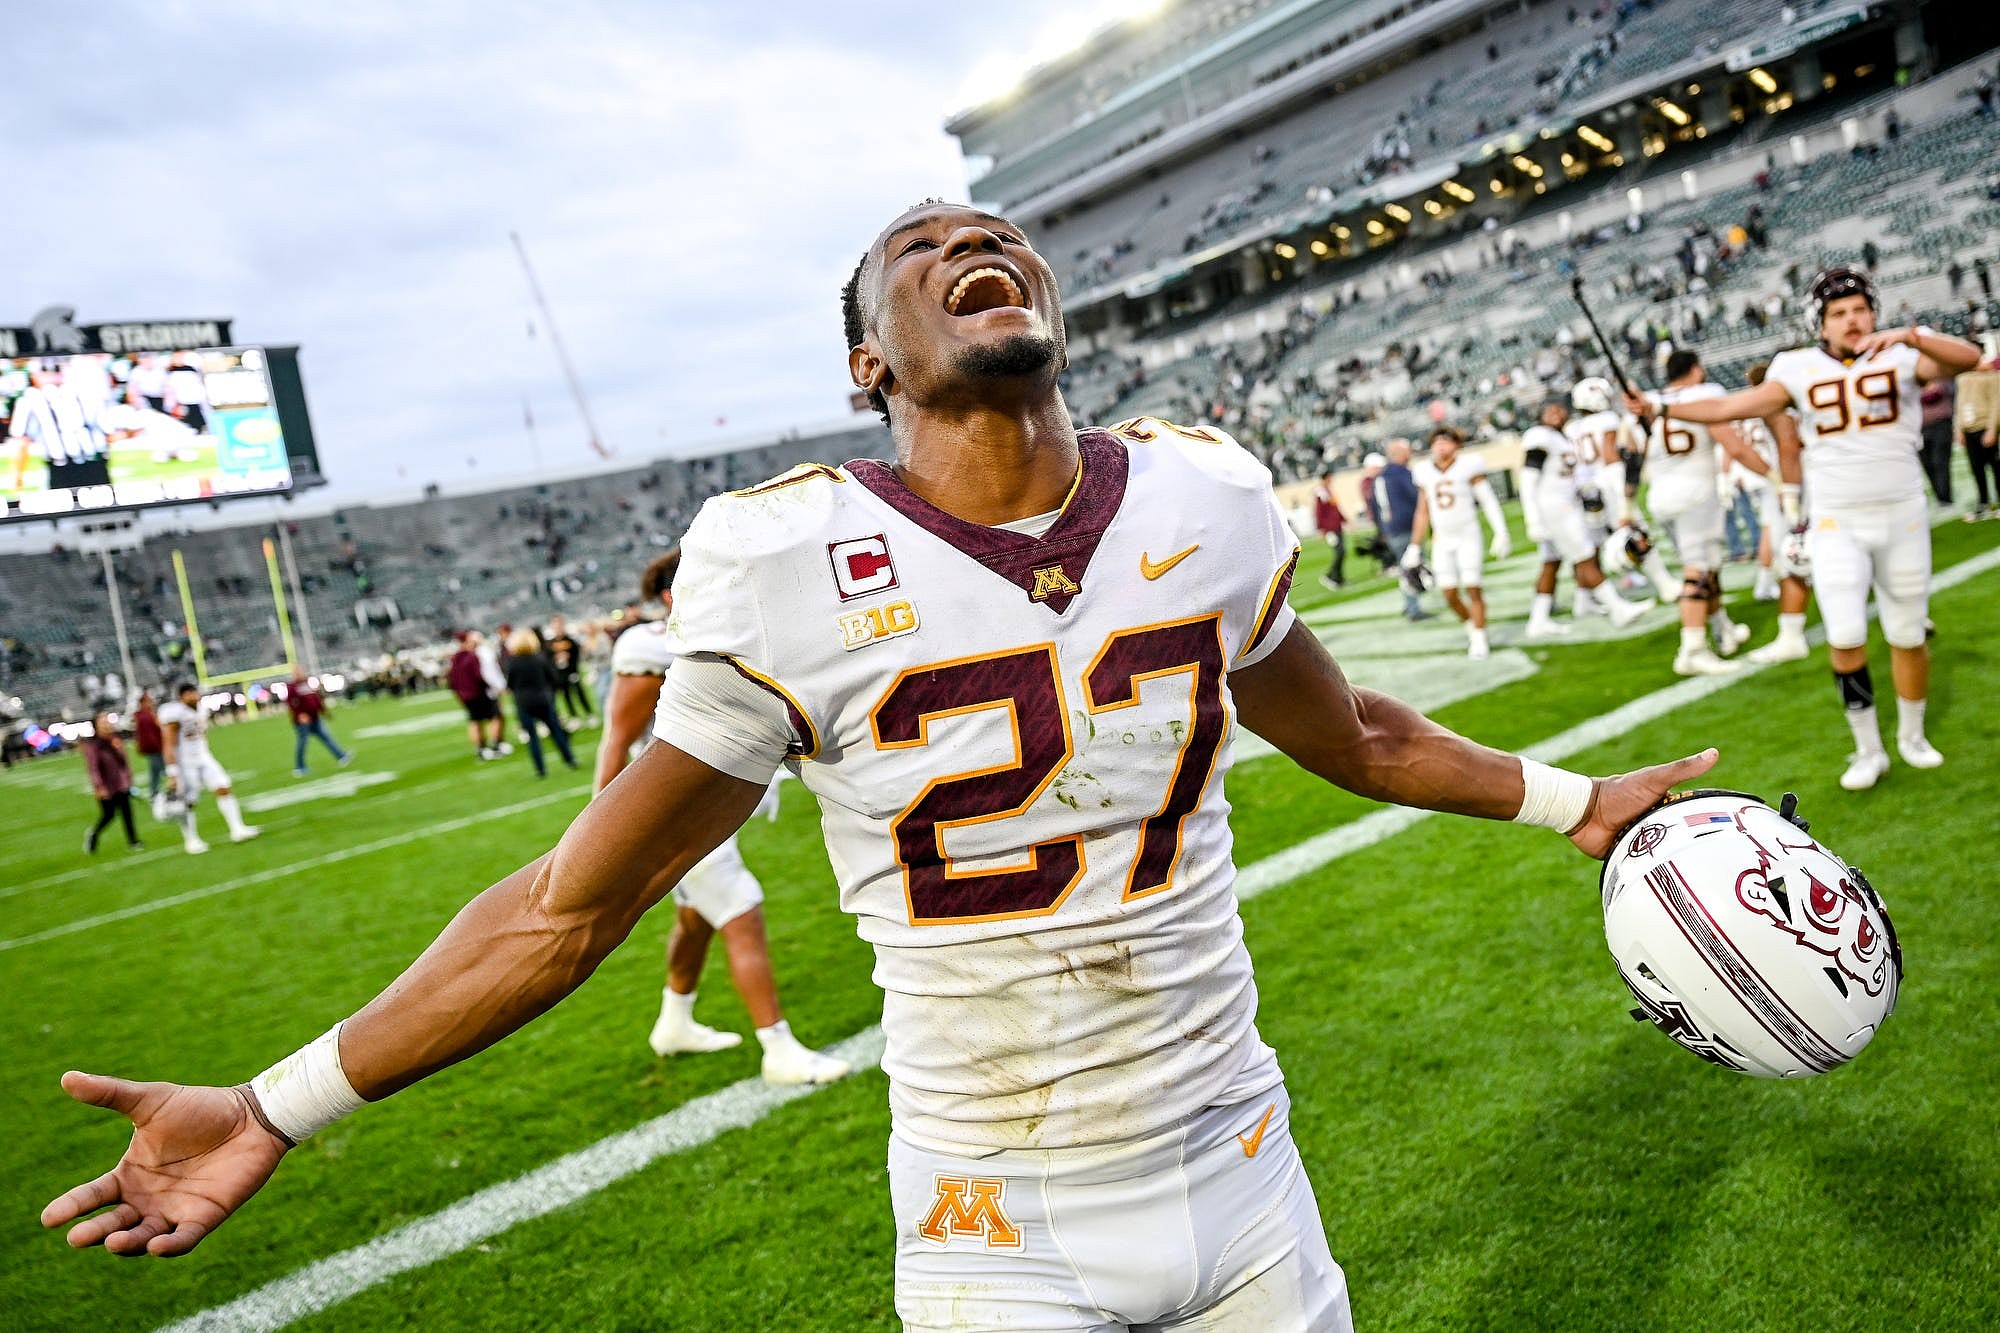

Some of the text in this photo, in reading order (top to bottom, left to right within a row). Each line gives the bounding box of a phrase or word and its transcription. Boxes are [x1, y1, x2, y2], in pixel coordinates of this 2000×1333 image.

[98, 322, 220, 351] STADIUM
[1807, 369, 1900, 437] 99
[832, 536, 893, 596] C
[1031, 564, 1079, 600] M
[869, 610, 1230, 927] 27
[917, 1176, 1021, 1248] M
